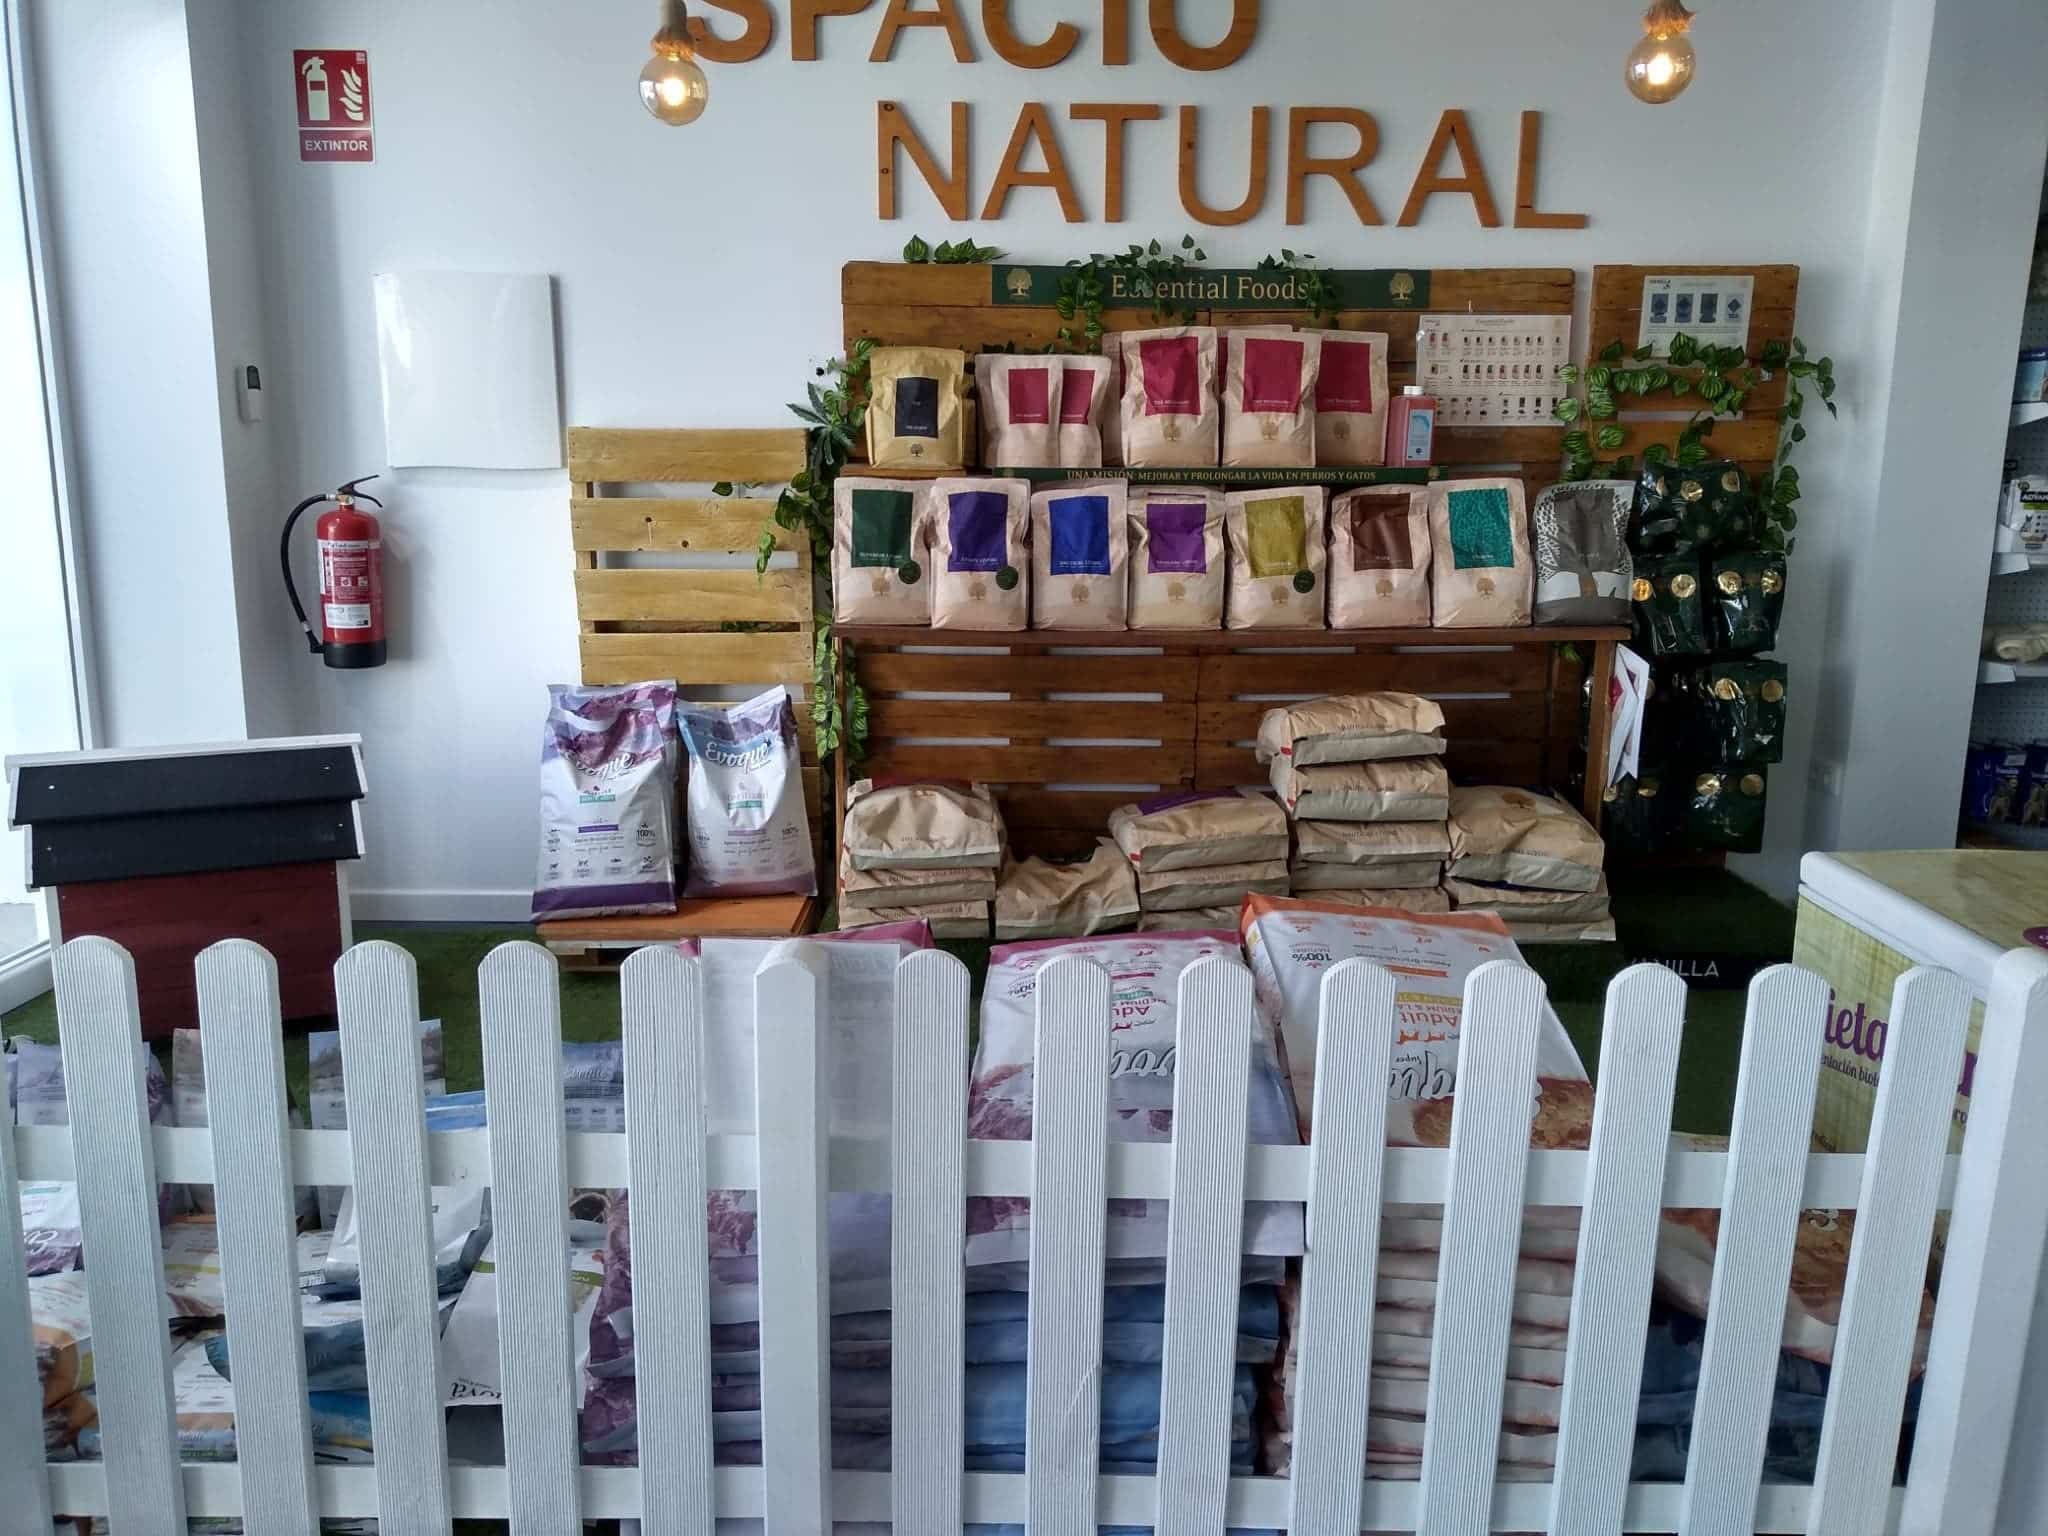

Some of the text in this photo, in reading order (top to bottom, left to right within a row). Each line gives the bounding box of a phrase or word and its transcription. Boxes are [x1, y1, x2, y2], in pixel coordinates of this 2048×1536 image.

[304, 140, 369, 151] EXTINTOR
[876, 100, 1587, 229] NATURAL
[1236, 274, 1309, 300] Foods
[1138, 471, 1181, 481] MEJORAR
[1191, 471, 1246, 481] PROLONGAR
[1248, 471, 1261, 481] LA
[1261, 471, 1286, 481] VIDA
[1286, 471, 1299, 480] EN
[1300, 471, 1337, 480] PERROS
[1346, 471, 1377, 480] GATOS
[704, 741, 772, 774] Evoque
[1291, 952, 1332, 962] 100%
[1400, 1012, 1458, 1028] Adult
